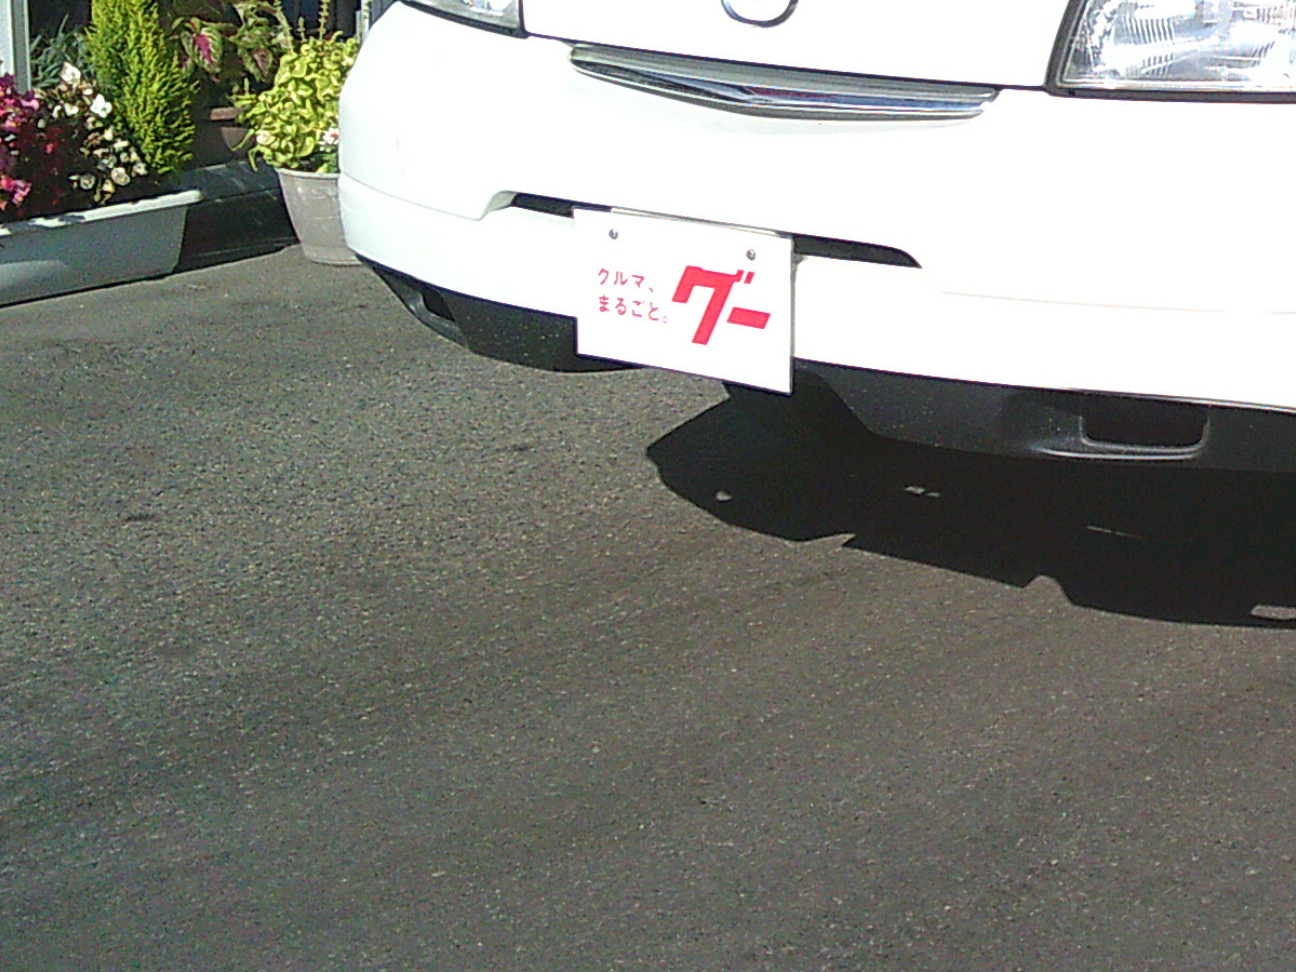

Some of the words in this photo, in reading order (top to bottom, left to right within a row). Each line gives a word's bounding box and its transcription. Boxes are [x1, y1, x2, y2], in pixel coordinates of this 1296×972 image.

[598, 267, 654, 293] クルマ、
[598, 294, 669, 325] まるごと。
[671, 265, 771, 345] グー
